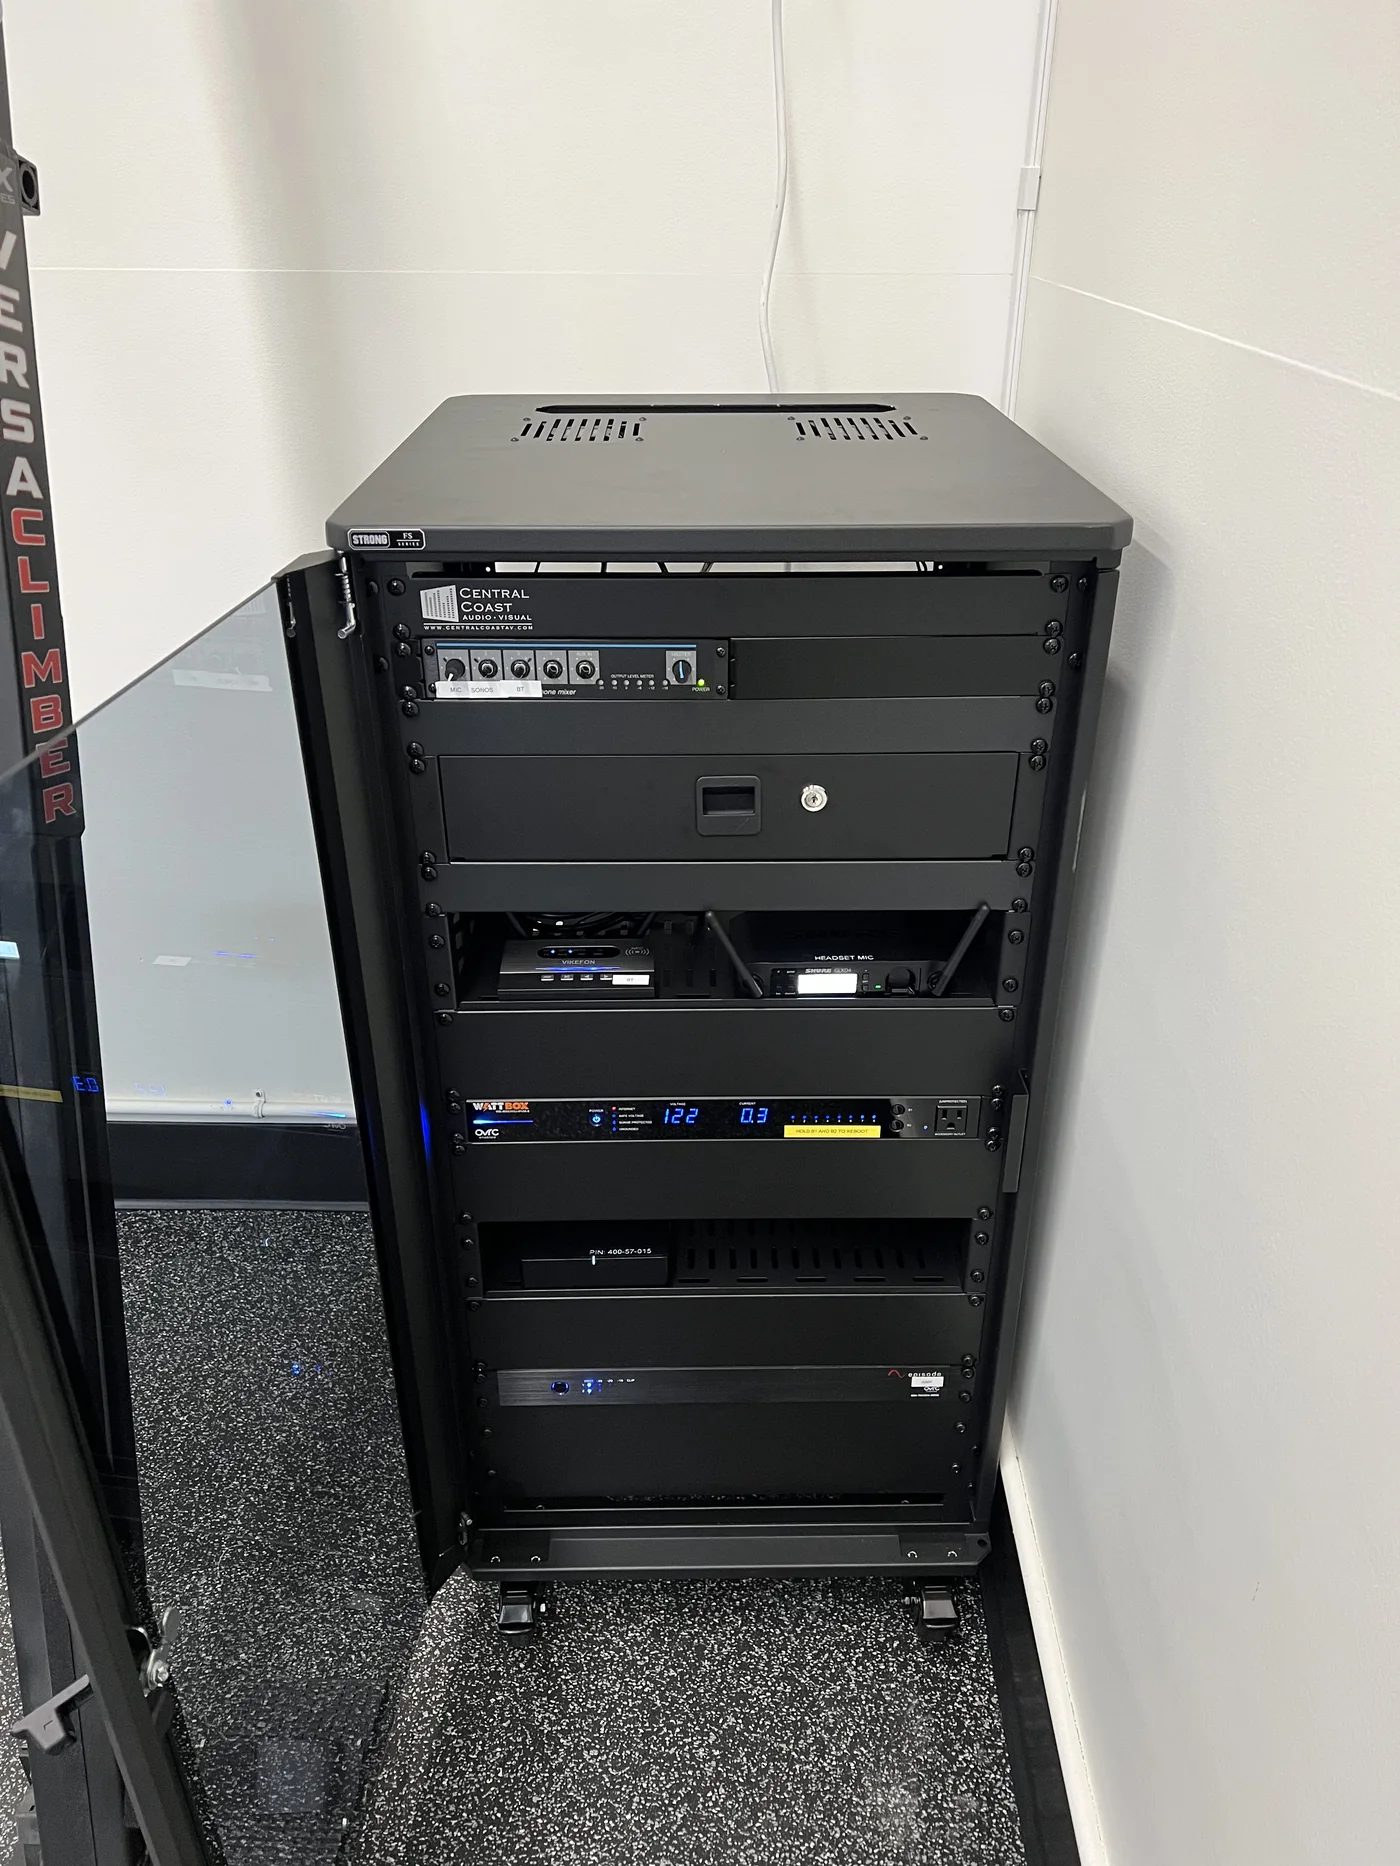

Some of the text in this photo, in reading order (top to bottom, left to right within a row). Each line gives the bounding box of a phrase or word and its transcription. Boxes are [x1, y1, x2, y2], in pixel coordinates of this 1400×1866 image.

[352, 534, 388, 545] STRONG
[459, 587, 530, 599] CENTRAL
[460, 601, 513, 612] COAST
[664, 1108, 699, 1124] 122
[607, 1247, 652, 1255] 400-57-015
